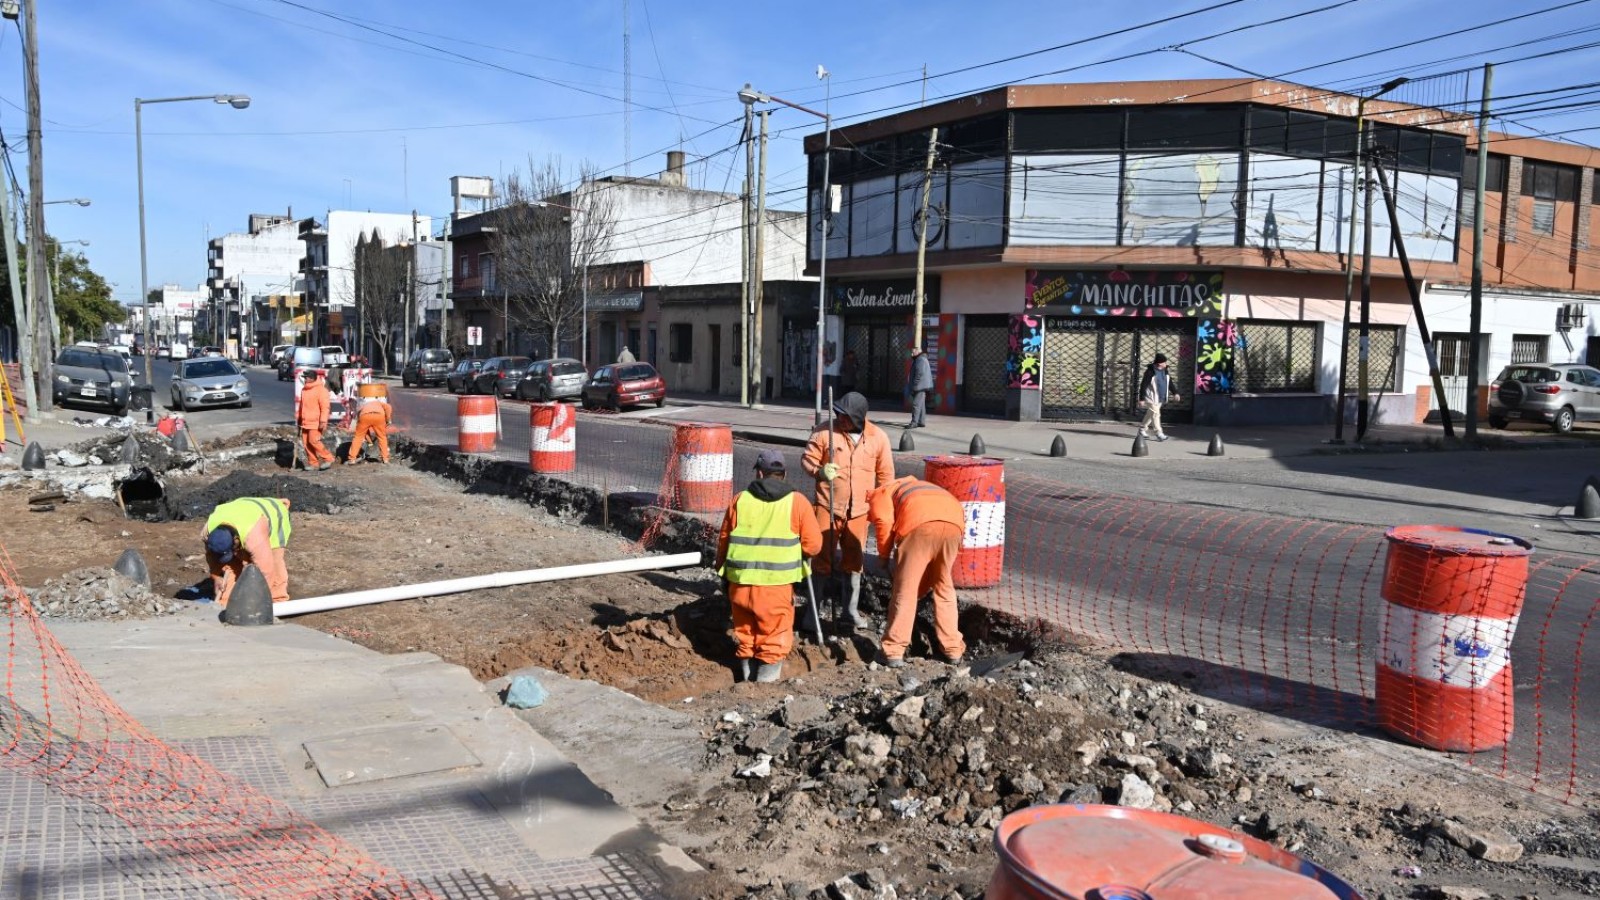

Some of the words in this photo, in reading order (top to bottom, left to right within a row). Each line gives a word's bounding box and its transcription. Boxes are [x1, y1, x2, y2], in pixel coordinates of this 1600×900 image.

[846, 287, 876, 307] Salon
[885, 286, 929, 306] Events
[1080, 283, 1208, 308] MANCHITAS
